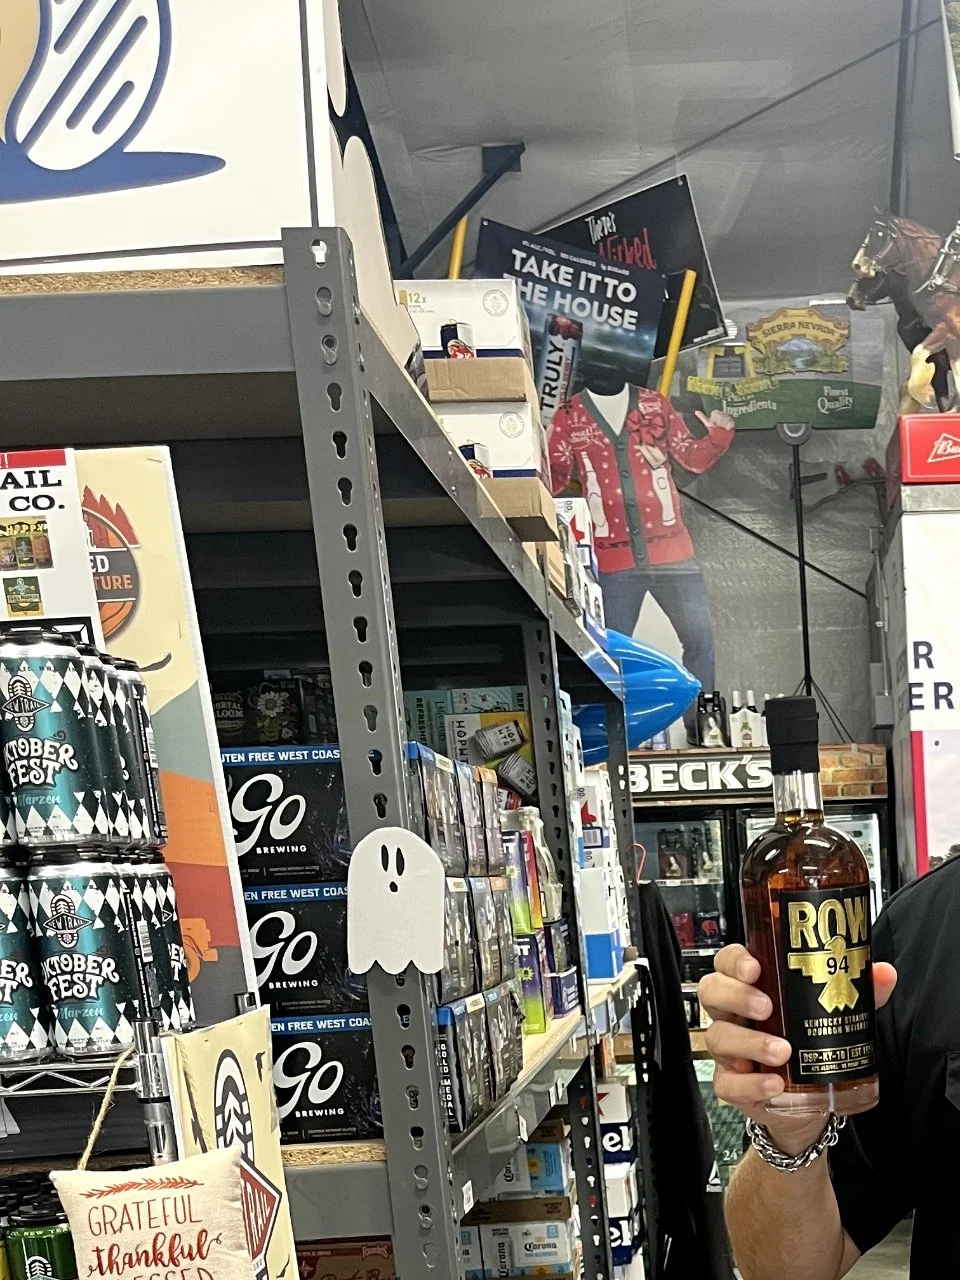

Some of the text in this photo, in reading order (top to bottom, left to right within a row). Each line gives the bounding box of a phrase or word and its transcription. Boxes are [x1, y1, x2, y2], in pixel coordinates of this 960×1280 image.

[511, 249, 637, 303] TAKE IT TO
[553, 291, 638, 332] HOUSE
[762, 321, 836, 338] SIERRA NEVADA
[540, 339, 564, 412] TRULY
[9, 494, 66, 511] CO.
[249, 752, 275, 761] FREE
[278, 751, 308, 761] WEST
[7, 759, 61, 788] FEST
[628, 755, 772, 793] BECK'S
[256, 845, 307, 854] BREWING
[261, 890, 287, 899] FREE
[290, 888, 319, 898] WEST
[788, 896, 867, 949] ROW
[826, 956, 849, 975] 94
[48, 973, 105, 1001] FEST
[268, 980, 318, 989] BREWING
[295, 1108, 344, 1118] BREWING
[723, 1151, 738, 1161] 24
[88, 1194, 202, 1237] GRATEFUL
[87, 1229, 222, 1277] thankful
[524, 1241, 557, 1252] Corona
